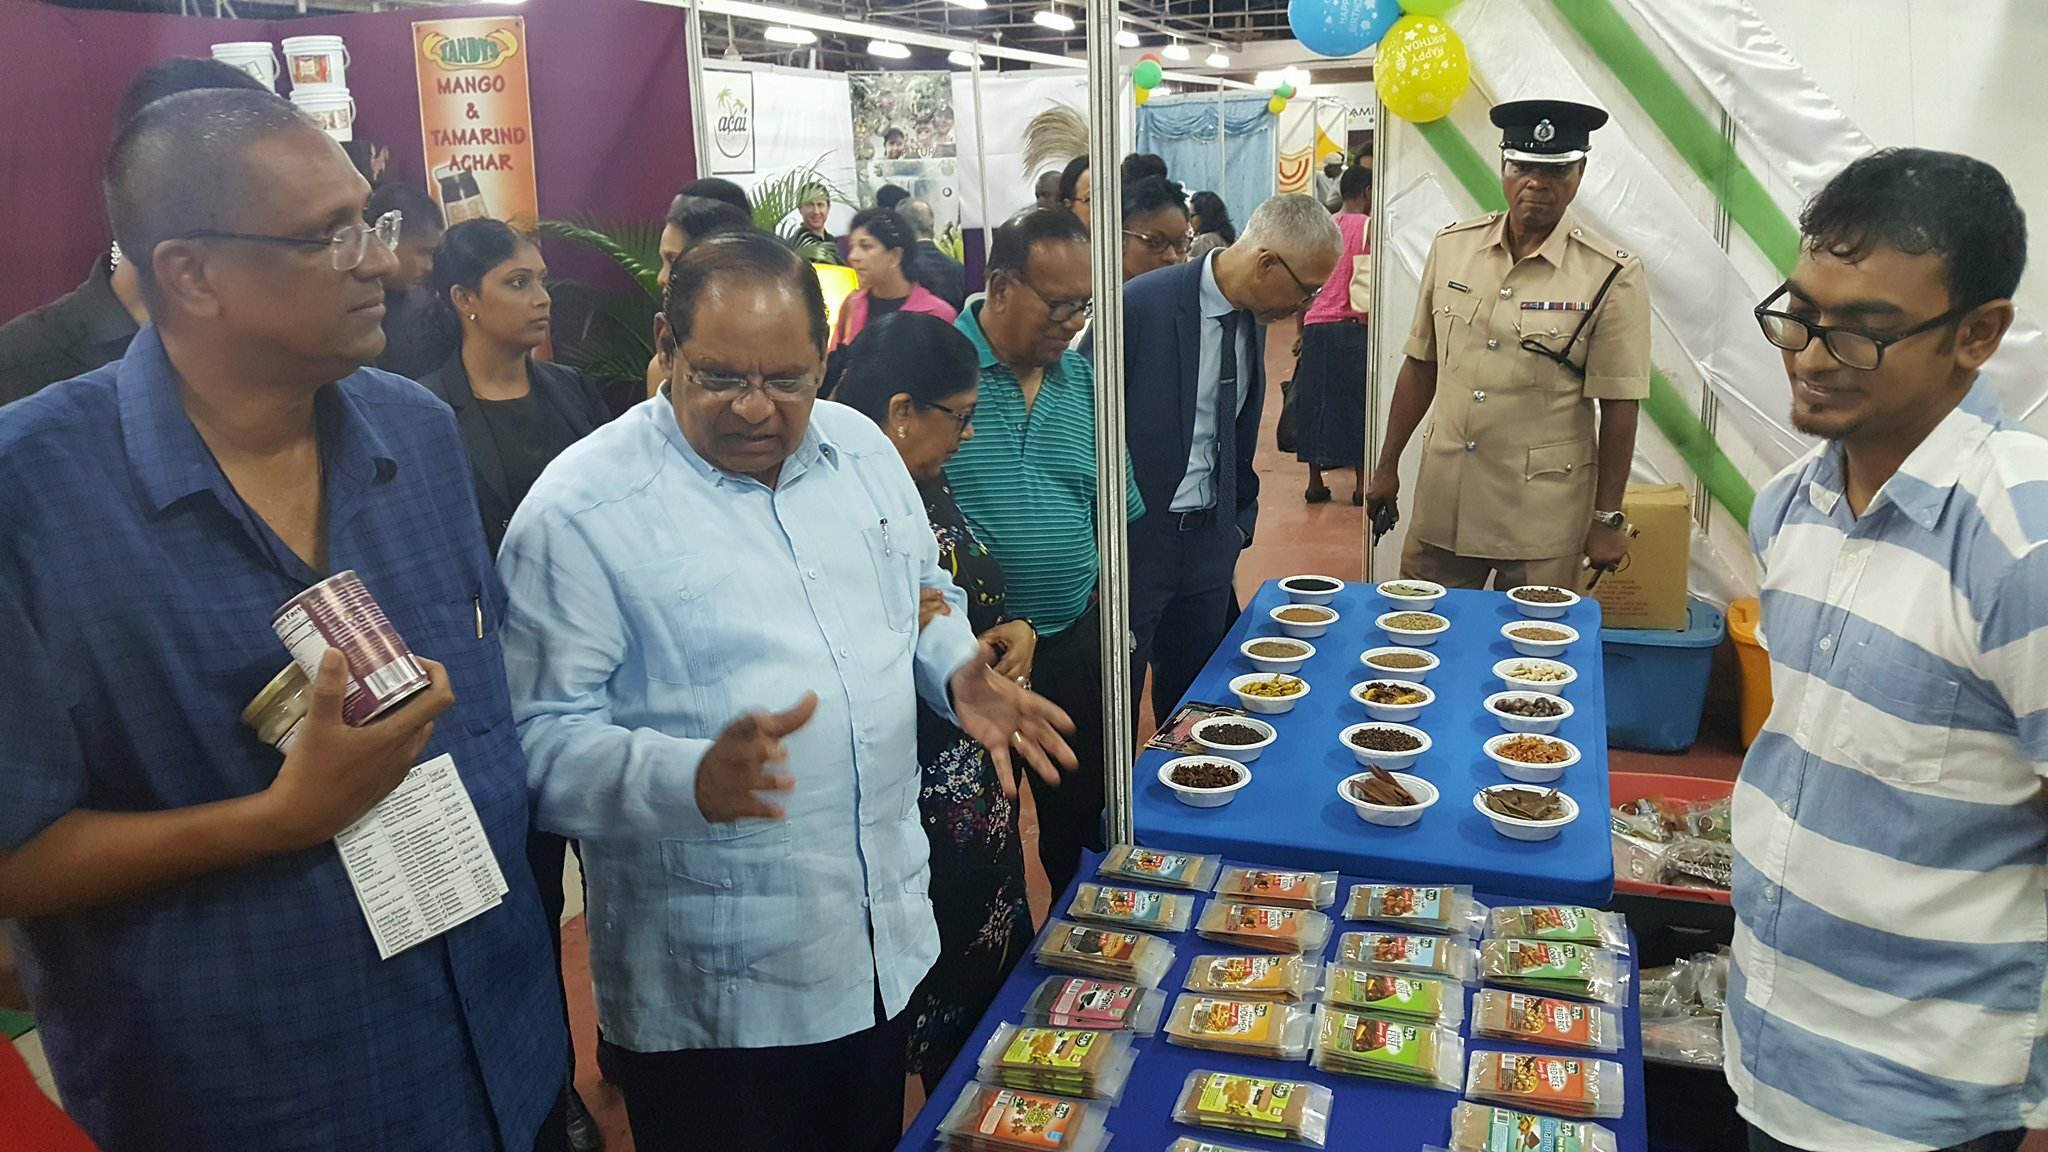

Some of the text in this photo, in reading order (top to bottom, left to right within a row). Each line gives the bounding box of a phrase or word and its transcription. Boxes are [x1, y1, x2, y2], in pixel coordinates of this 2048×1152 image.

[1411, 47, 1445, 64] HAPPY
[437, 75, 505, 95] MANGO
[465, 102, 480, 120] &
[718, 110, 748, 134] açai
[430, 127, 526, 147] TAMARIND
[449, 154, 513, 172] ACHAR
